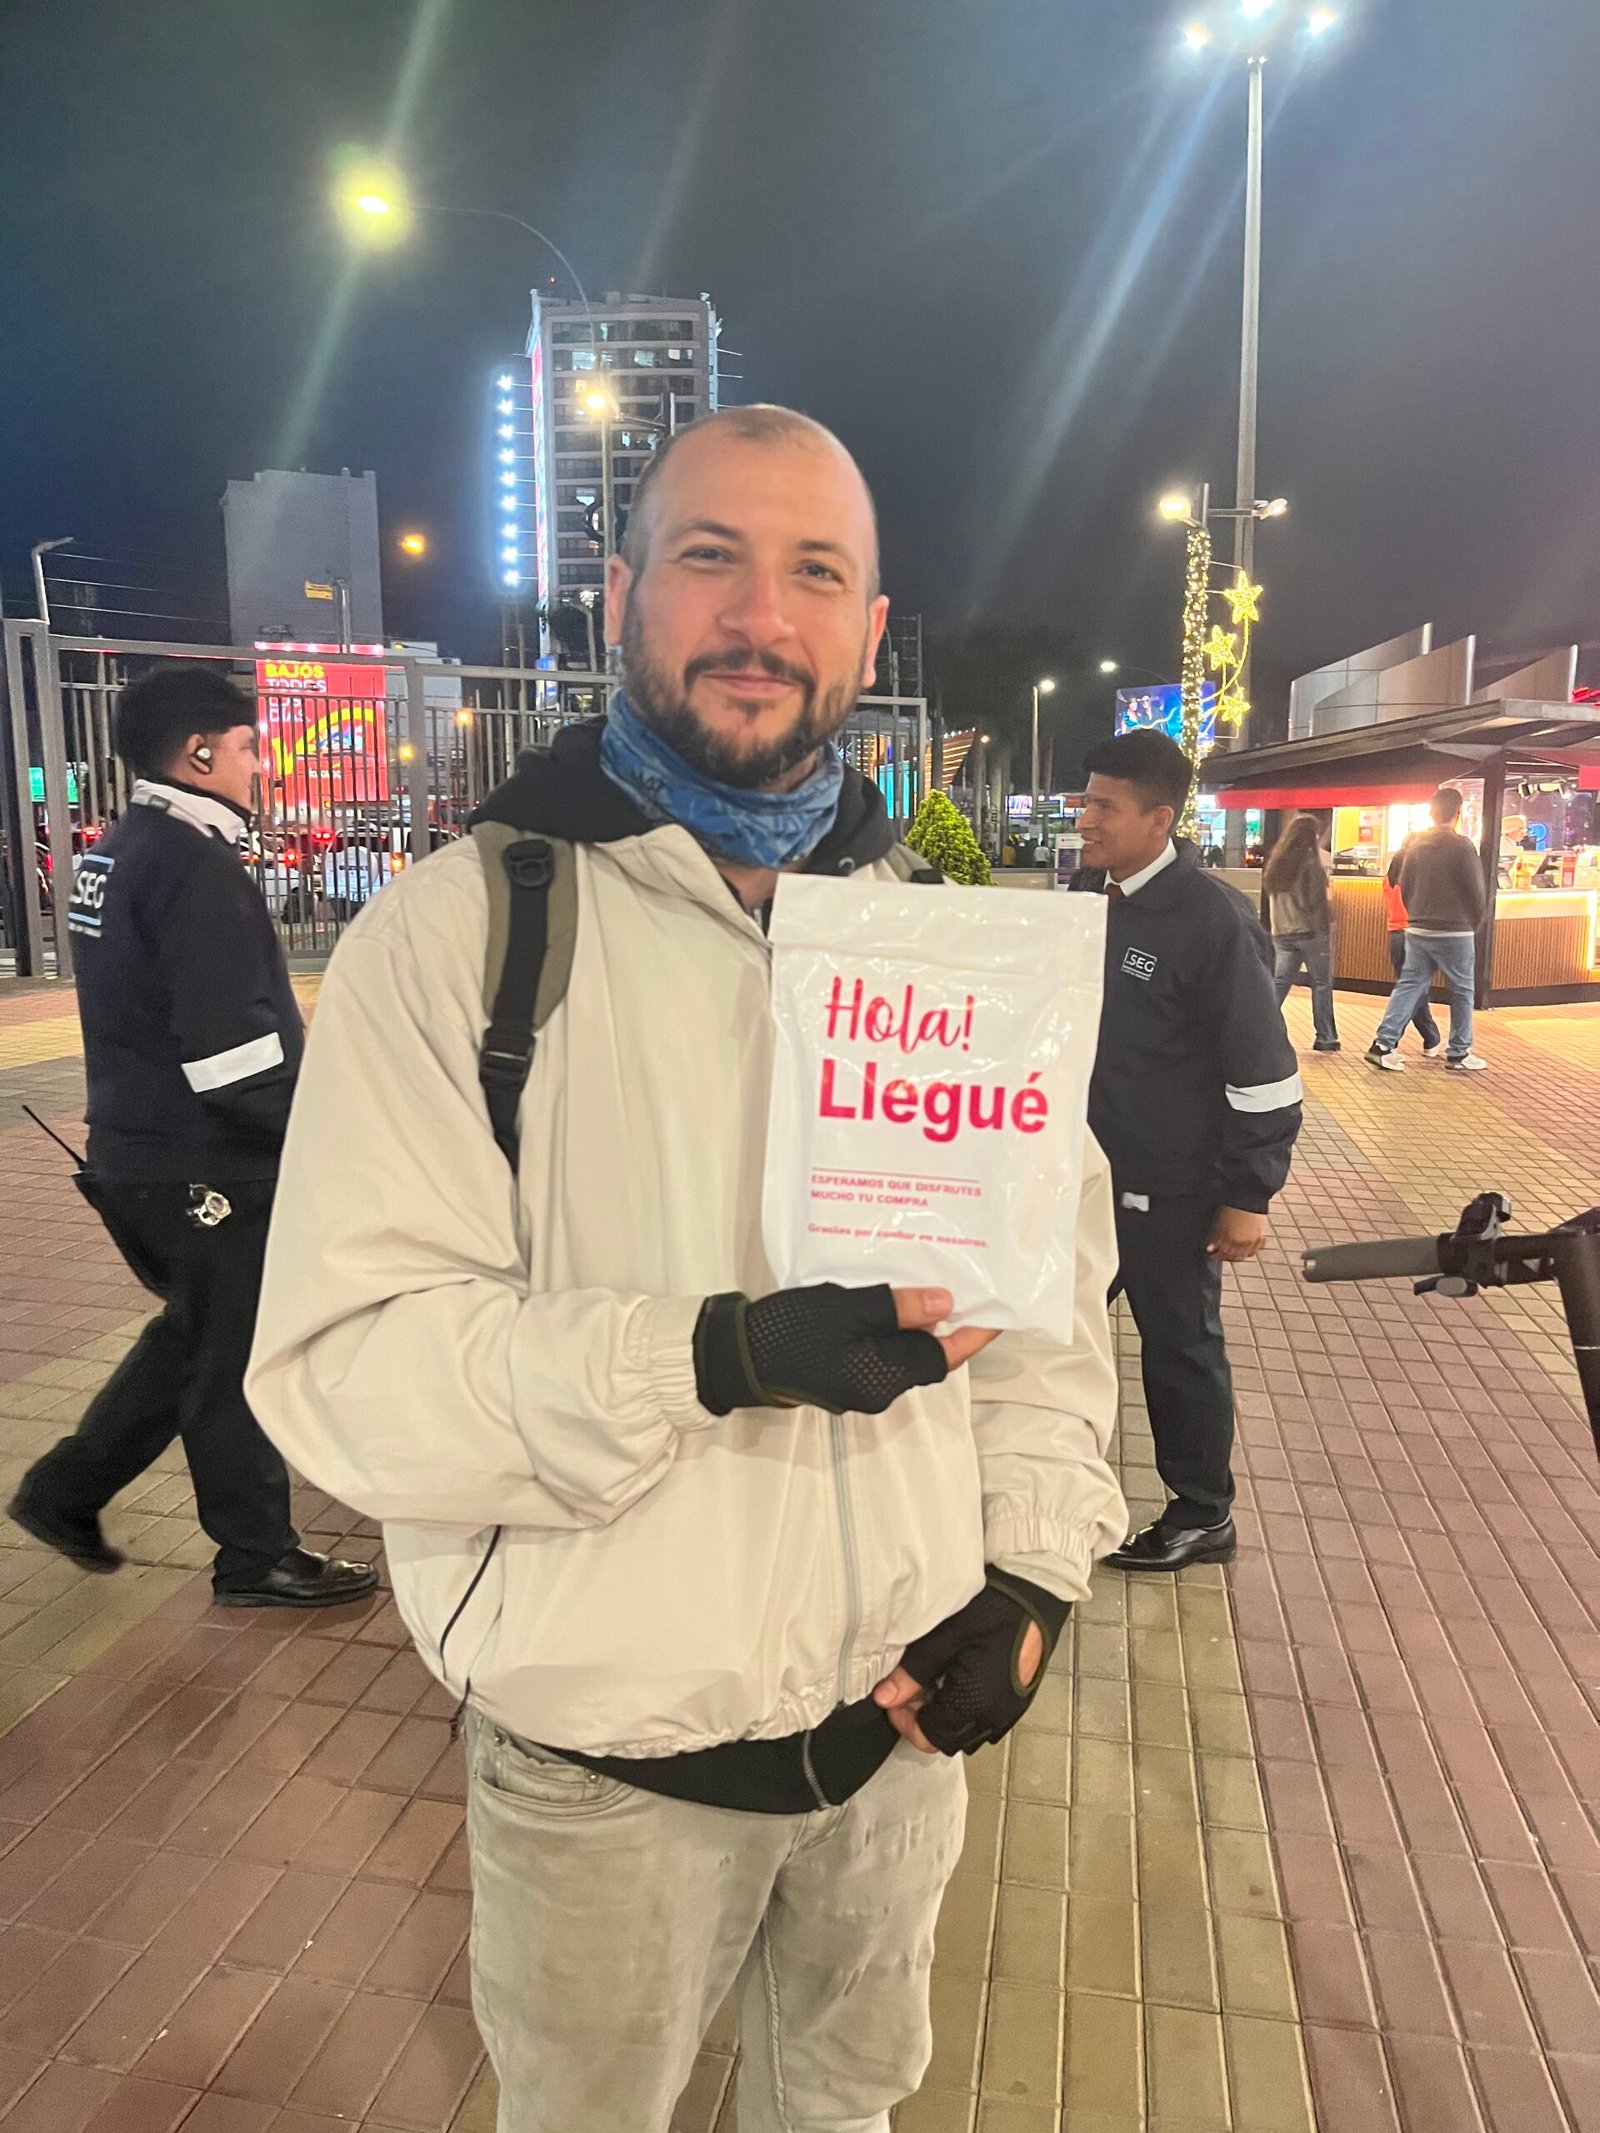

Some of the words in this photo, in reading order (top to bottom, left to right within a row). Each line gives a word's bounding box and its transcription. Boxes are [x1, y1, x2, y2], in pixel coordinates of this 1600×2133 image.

[265, 663, 325, 679] BAJOS
[265, 678, 327, 693] TODOS
[824, 976, 974, 1054] Hola!
[819, 1058, 1048, 1143] Llegué
[811, 1174, 884, 1189] ESPERAMOS
[887, 1180, 912, 1191] QUE
[915, 1182, 982, 1197] DISFRUTES
[810, 1189, 855, 1201] MUCHO
[858, 1193, 874, 1202] TU
[876, 1195, 929, 1207] COMPRA
[807, 1223, 851, 1236] Gracias
